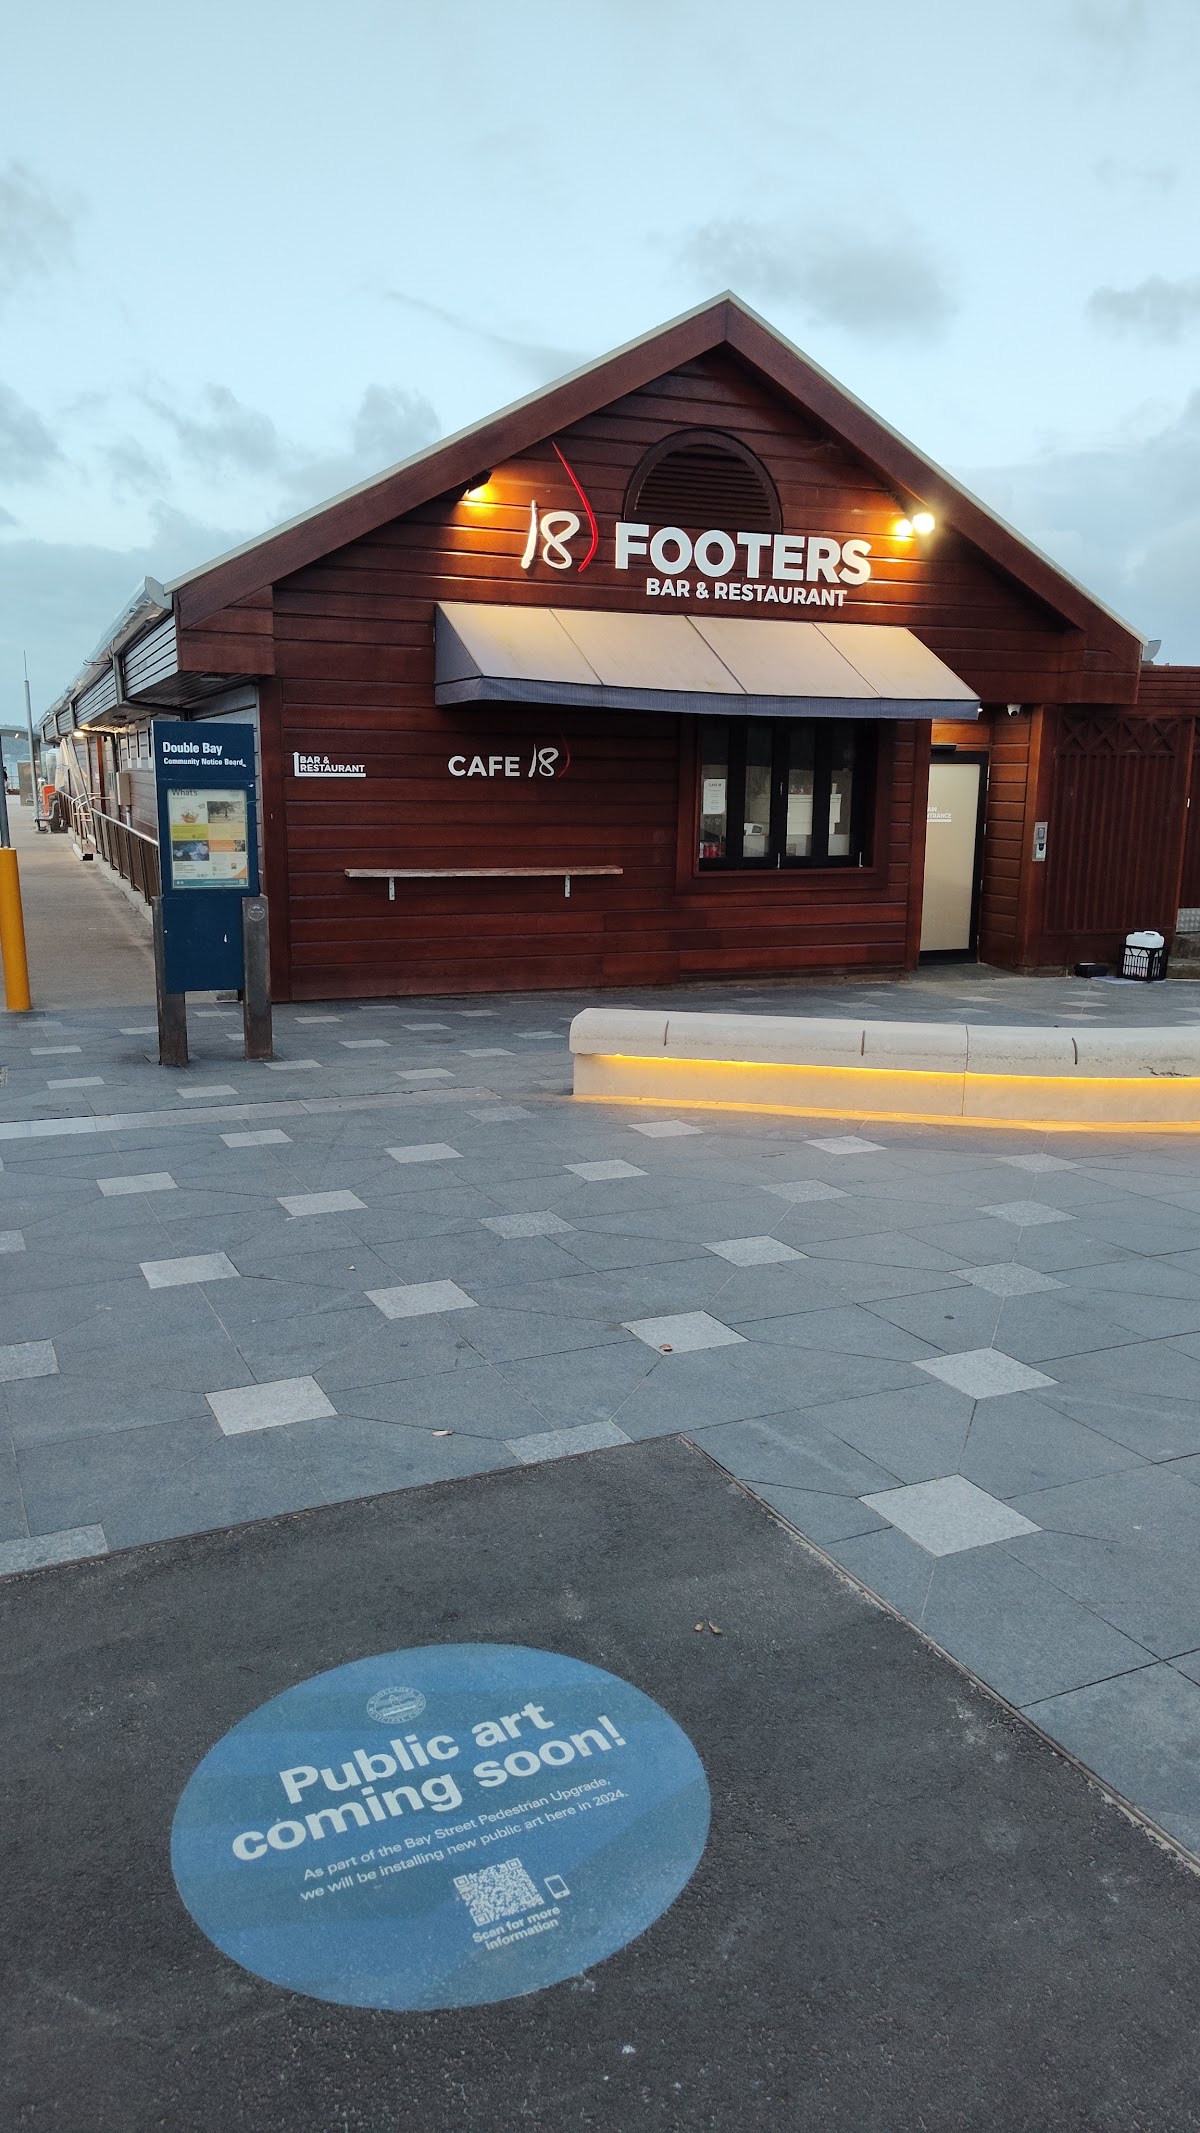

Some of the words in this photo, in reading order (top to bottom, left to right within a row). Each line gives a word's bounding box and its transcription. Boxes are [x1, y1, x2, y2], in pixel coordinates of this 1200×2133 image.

[521, 500, 580, 569] 18
[615, 521, 872, 586] FOOTERS
[646, 578, 690, 598] BAR
[696, 581, 709, 599] &
[714, 582, 848, 606] RESTAURANT
[162, 741, 200, 753] Double
[202, 742, 223, 756] Bay
[163, 757, 200, 767] Community
[201, 758, 223, 766] Notice
[224, 758, 244, 766] Board
[300, 756, 321, 764] BAR
[322, 756, 330, 764] &
[448, 755, 521, 777] CAFE
[528, 744, 559, 777] 18
[300, 764, 366, 773] RESTAURANT
[171, 788, 199, 796] What's
[279, 1734, 460, 1804] Public
[471, 1702, 555, 1747] art
[232, 1773, 463, 1860] coming
[473, 1715, 627, 1787] soon!
[300, 1886, 325, 1900] we
[327, 1875, 354, 1893] will
[356, 1871, 377, 1884] be
[379, 1850, 445, 1877] installing
[446, 1838, 477, 1855] new
[479, 1823, 522, 1845] public
[524, 1816, 545, 1830] art
[544, 1807, 577, 1822] here
[578, 1801, 592, 1812] in
[592, 1789, 629, 1807] 2024.
[304, 1867, 325, 1881] As
[327, 1856, 358, 1875] part
[360, 1850, 376, 1863] of
[378, 1844, 402, 1857] the
[404, 1834, 431, 1849] Bay
[434, 1819, 478, 1840] Street
[478, 1797, 550, 1826] Pedestrian
[549, 1777, 611, 1802] Upgrade,
[472, 1925, 505, 1943] Scan
[506, 1918, 524, 1931] for
[526, 1906, 561, 1924] more
[484, 1918, 560, 1950] information
